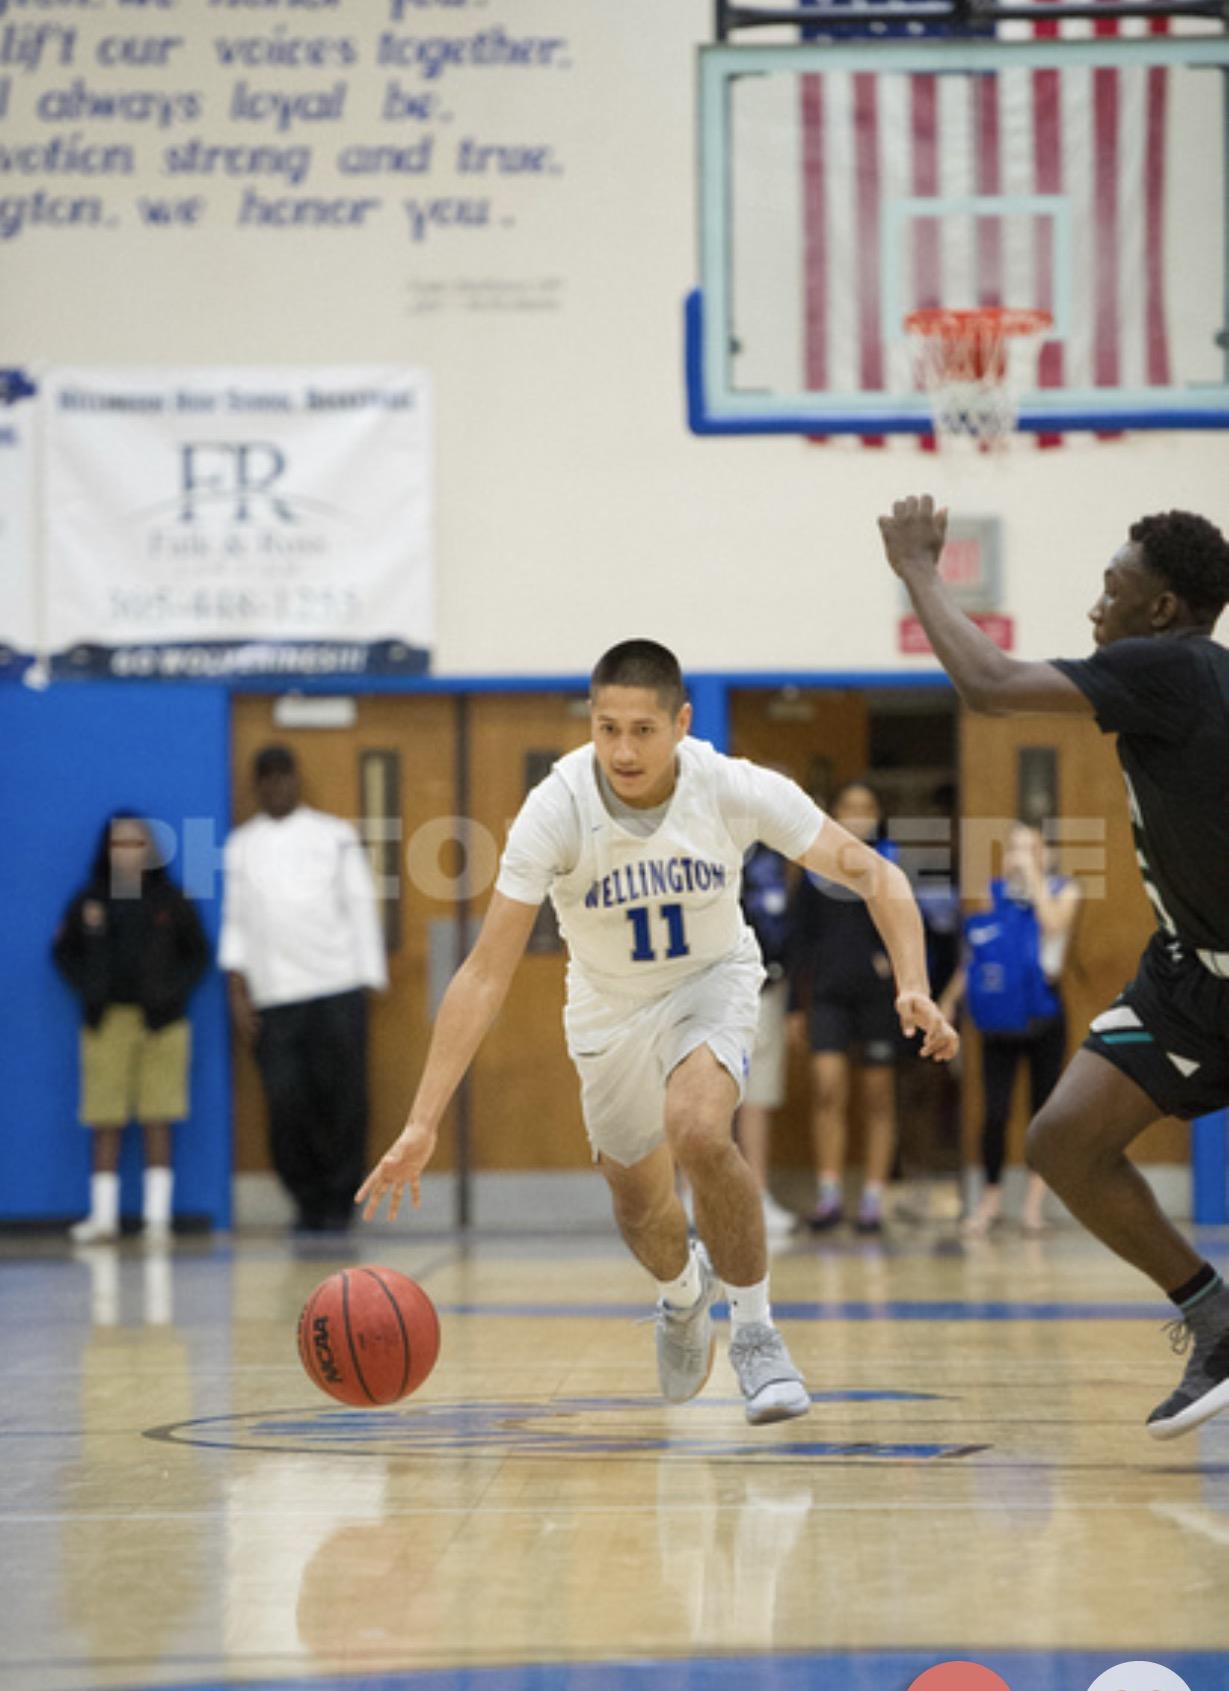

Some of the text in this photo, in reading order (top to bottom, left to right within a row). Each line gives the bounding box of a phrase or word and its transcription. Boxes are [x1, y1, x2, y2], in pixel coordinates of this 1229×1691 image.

[97, 36, 184, 66] our
[214, 25, 358, 66] voices
[37, 78, 203, 127] always
[229, 82, 347, 131] loyal
[163, 140, 311, 184] strong
[337, 136, 434, 175] and
[138, 198, 204, 226] we
[237, 187, 382, 227] honor
[179, 442, 297, 523] FR
[585, 857, 725, 908] WELLINGTON
[627, 904, 690, 961] 11
[313, 1315, 343, 1383] NCAA
